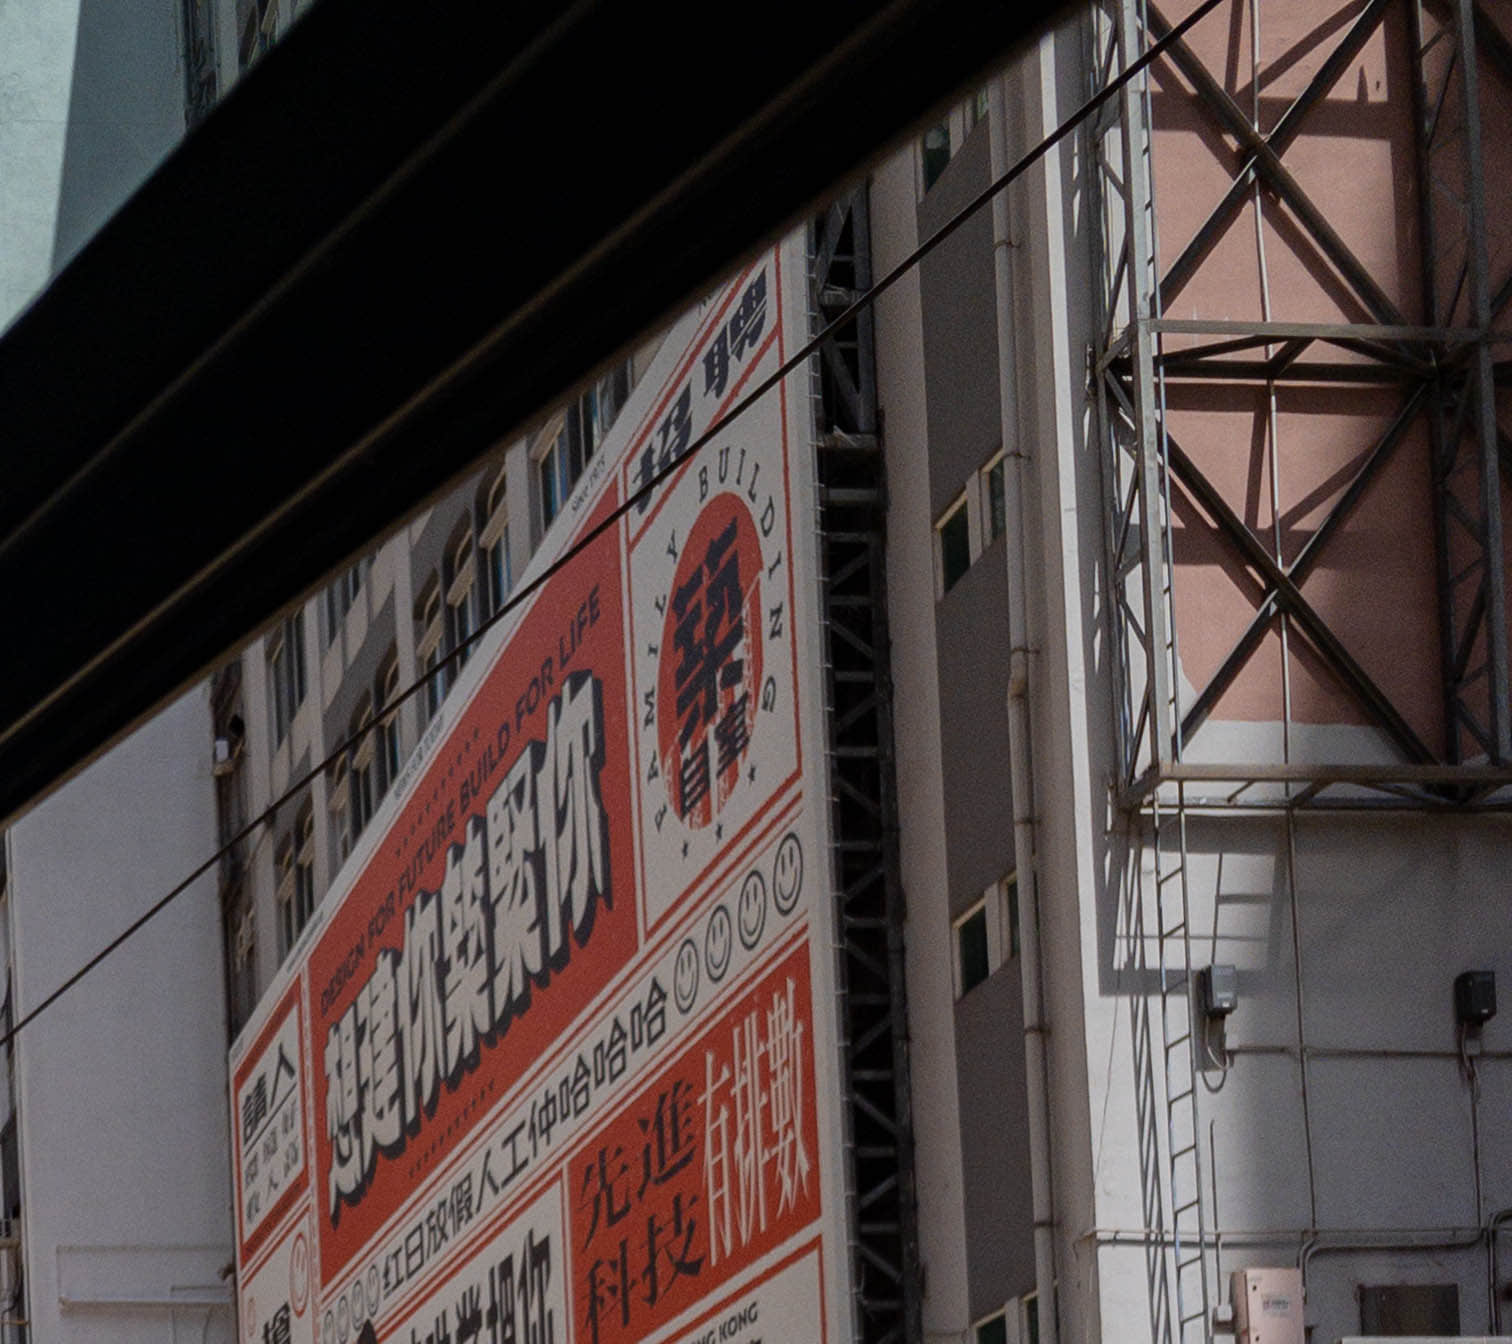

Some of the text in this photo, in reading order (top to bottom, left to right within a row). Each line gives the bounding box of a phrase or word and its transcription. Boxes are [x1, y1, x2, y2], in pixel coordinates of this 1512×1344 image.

[632, 267, 767, 515] 招聘
[644, 530, 680, 829] FAMILY
[699, 447, 783, 713] BUILDING
[320, 933, 365, 1016] DESIGN
[369, 890, 395, 949] FOR
[399, 800, 457, 905] FUTURE
[460, 722, 510, 812] BUILD
[514, 656, 554, 732] FOR
[558, 583, 601, 671] LIFE
[242, 1041, 296, 1147] 請人
[577, 1078, 694, 1250] 先進
